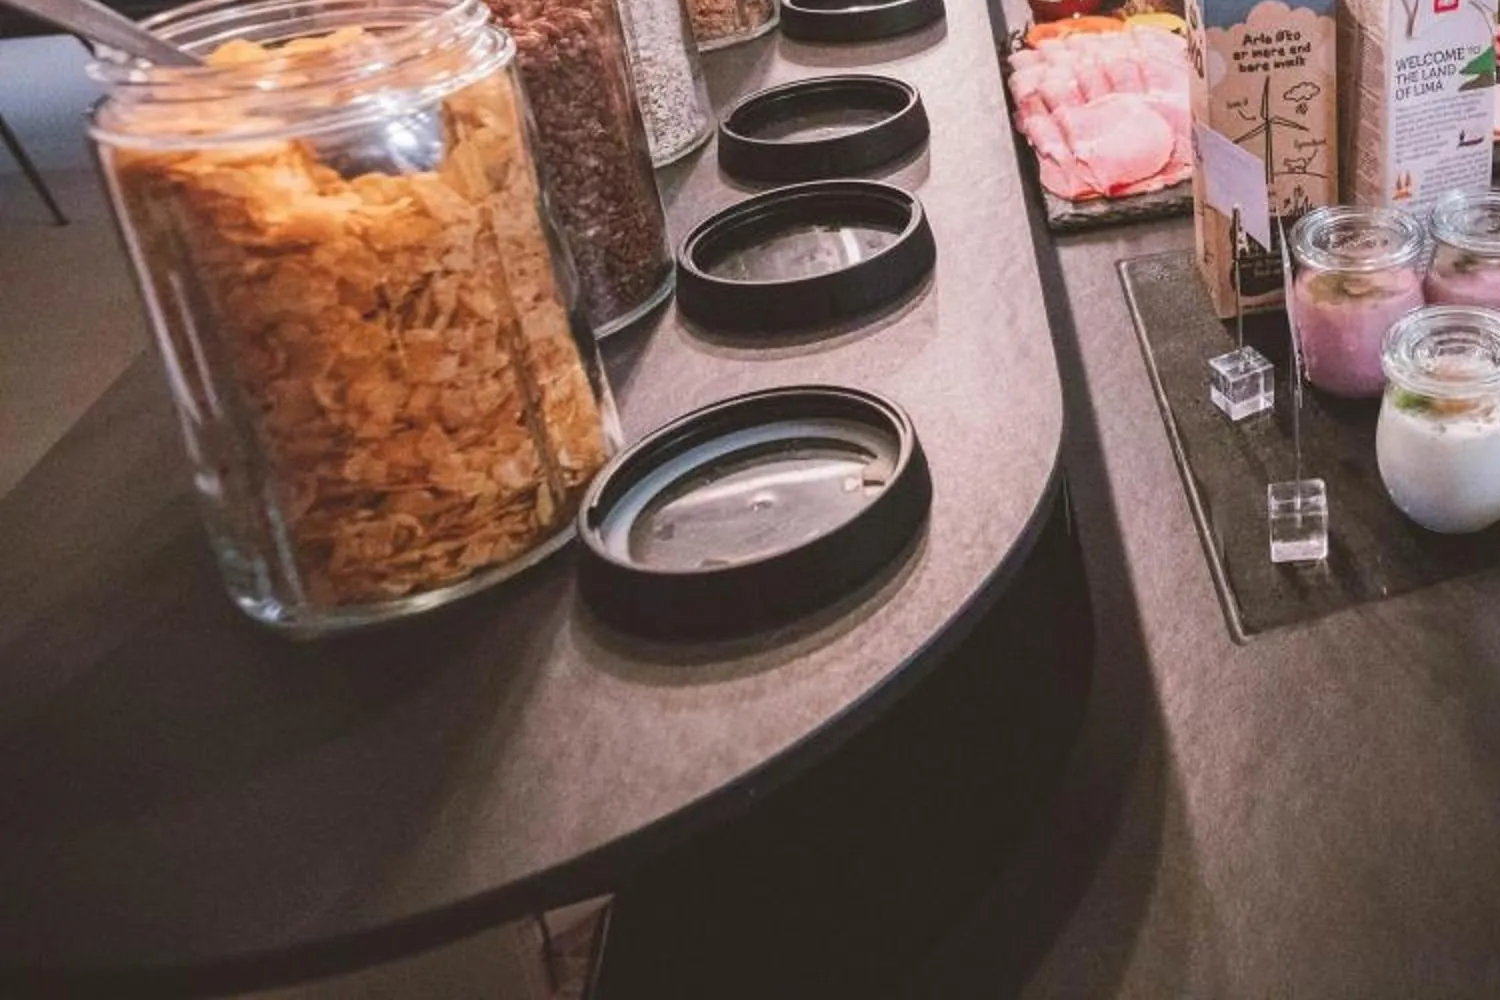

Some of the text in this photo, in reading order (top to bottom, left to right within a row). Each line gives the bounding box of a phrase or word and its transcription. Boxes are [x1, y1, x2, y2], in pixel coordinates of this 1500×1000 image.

[1243, 32, 1272, 46] Arla
[1396, 47, 1465, 71] WELCOME
[1396, 63, 1456, 85] THE LAND
[1395, 80, 1443, 101] OF LIMA
